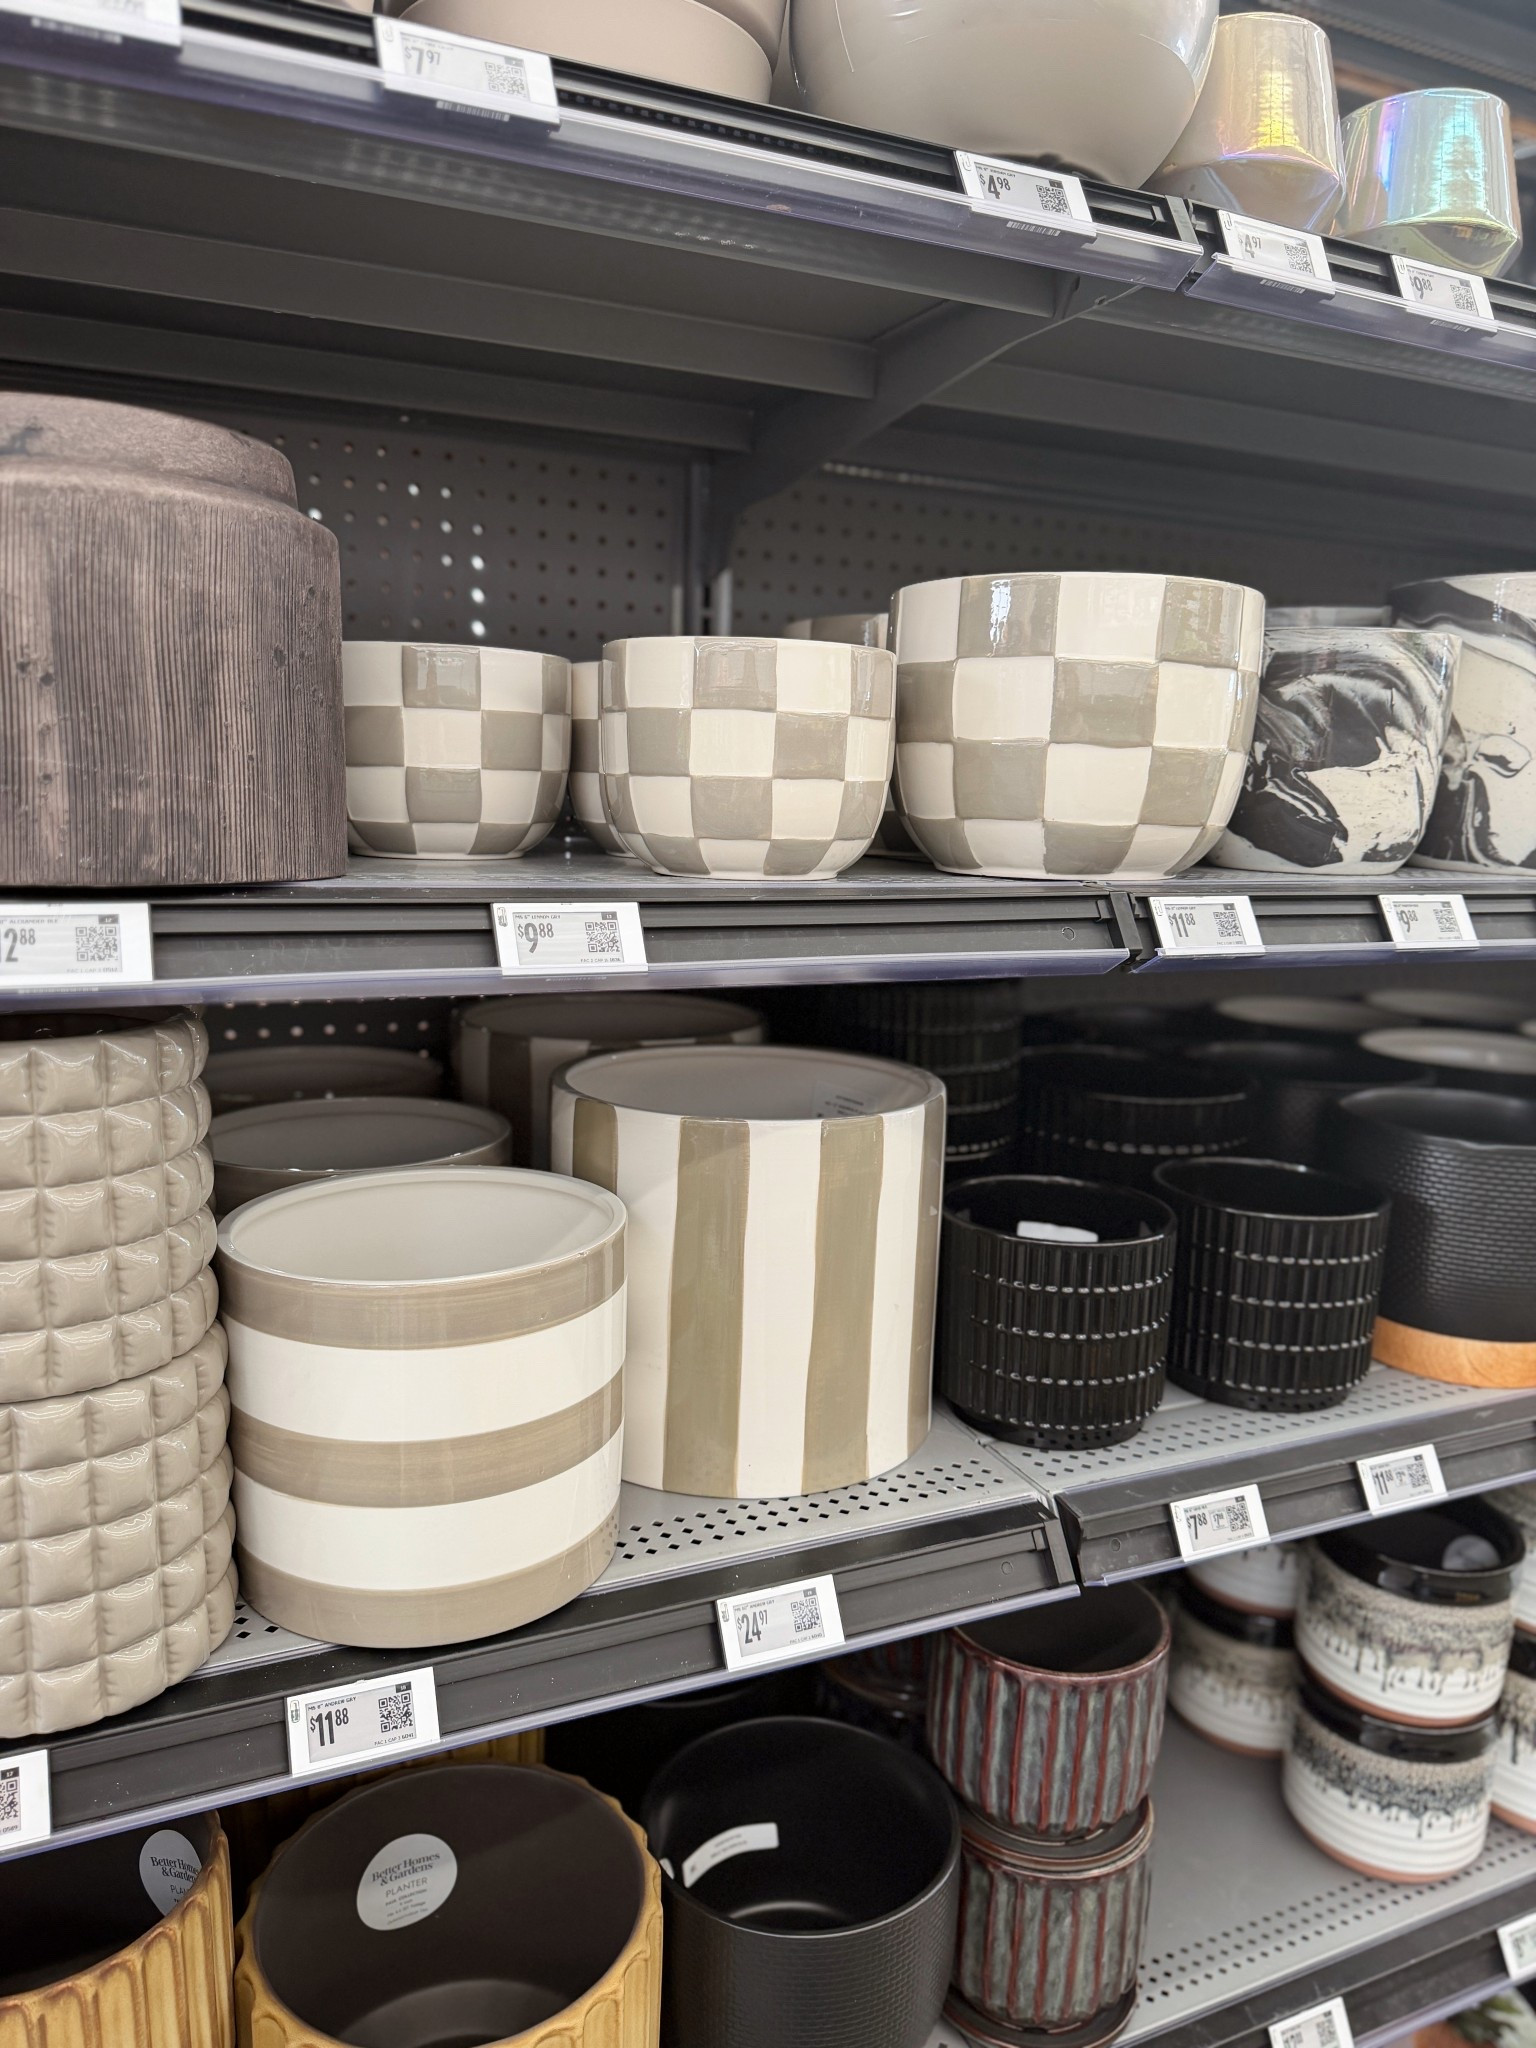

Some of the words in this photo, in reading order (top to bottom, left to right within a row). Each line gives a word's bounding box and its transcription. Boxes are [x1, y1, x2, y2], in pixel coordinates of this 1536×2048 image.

[150, 1856, 177, 1869] Better
[161, 1866, 170, 1877] &
[371, 1862, 402, 1883] Better
[403, 1852, 441, 1869] Homes
[380, 1878, 389, 1887] &
[389, 1862, 434, 1881] Gardens
[385, 1876, 429, 1898] PLANTER
